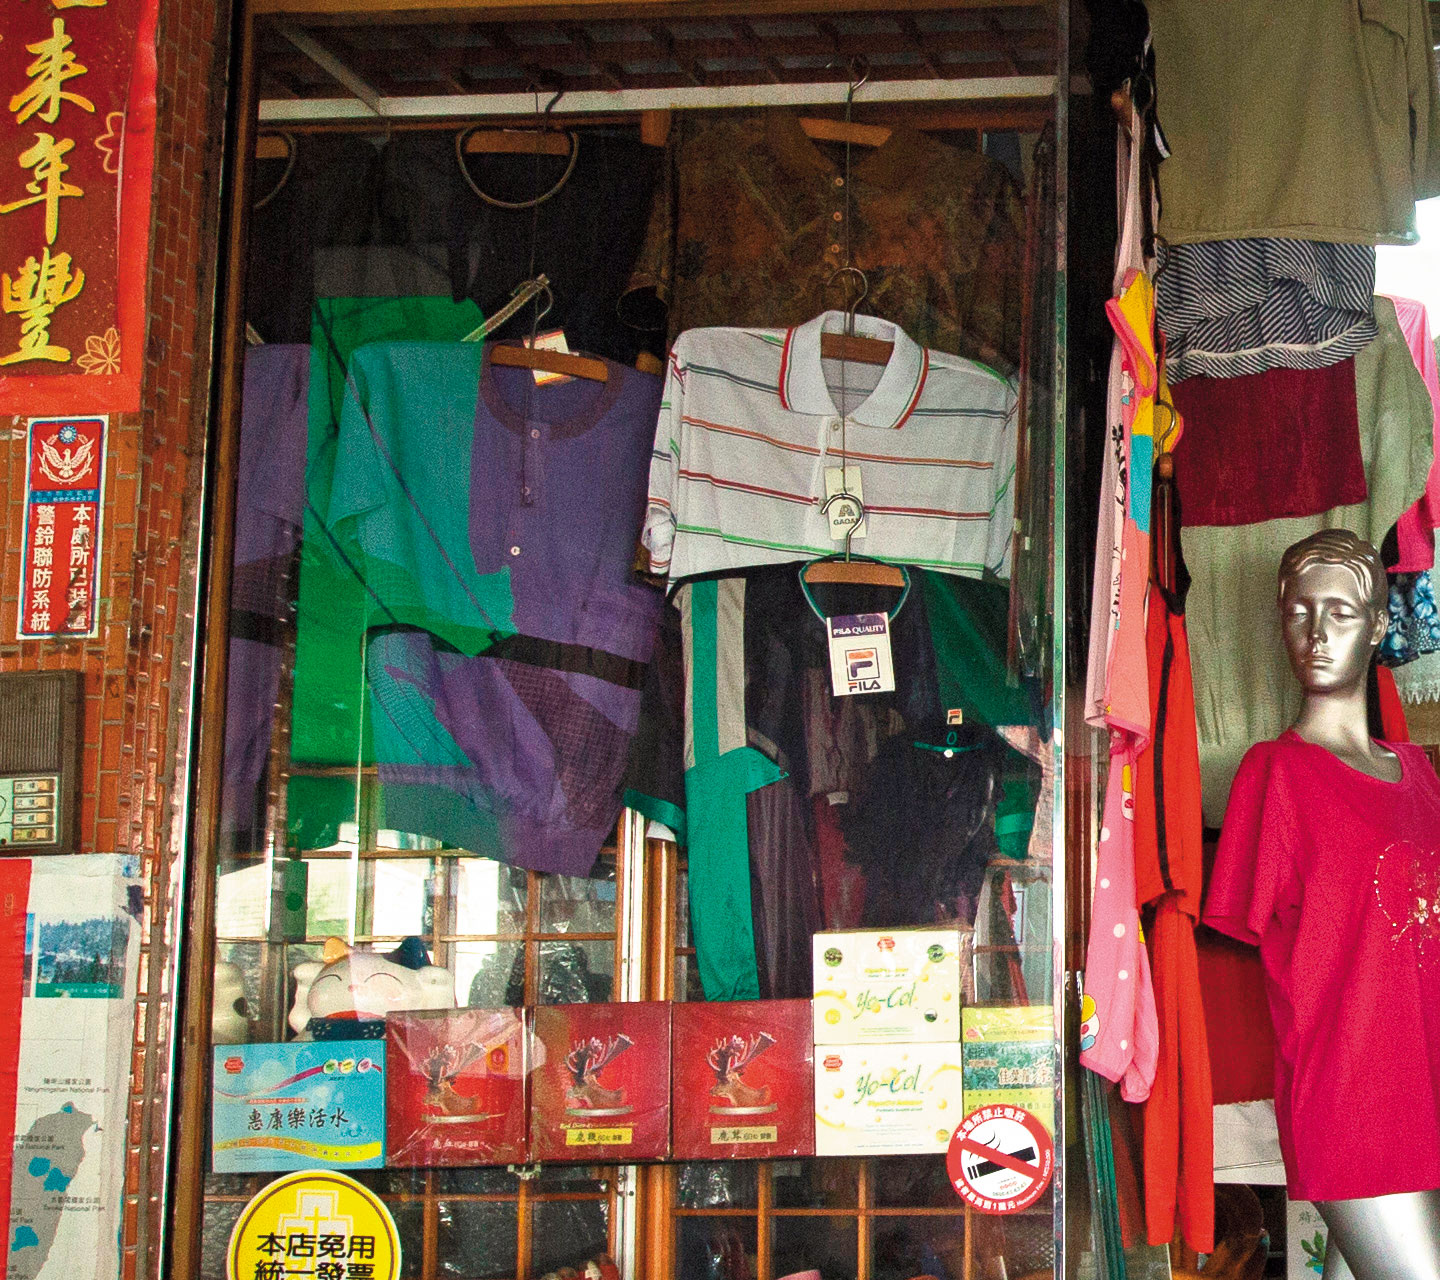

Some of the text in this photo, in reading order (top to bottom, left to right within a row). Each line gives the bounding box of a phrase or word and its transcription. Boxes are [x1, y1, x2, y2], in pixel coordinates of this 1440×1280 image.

[30, 504, 56, 632] 警鈴聯防系統
[833, 624, 885, 636] FILA QUALITY
[847, 679, 882, 693] FILA
[256, 1232, 376, 1260] 本店免用
